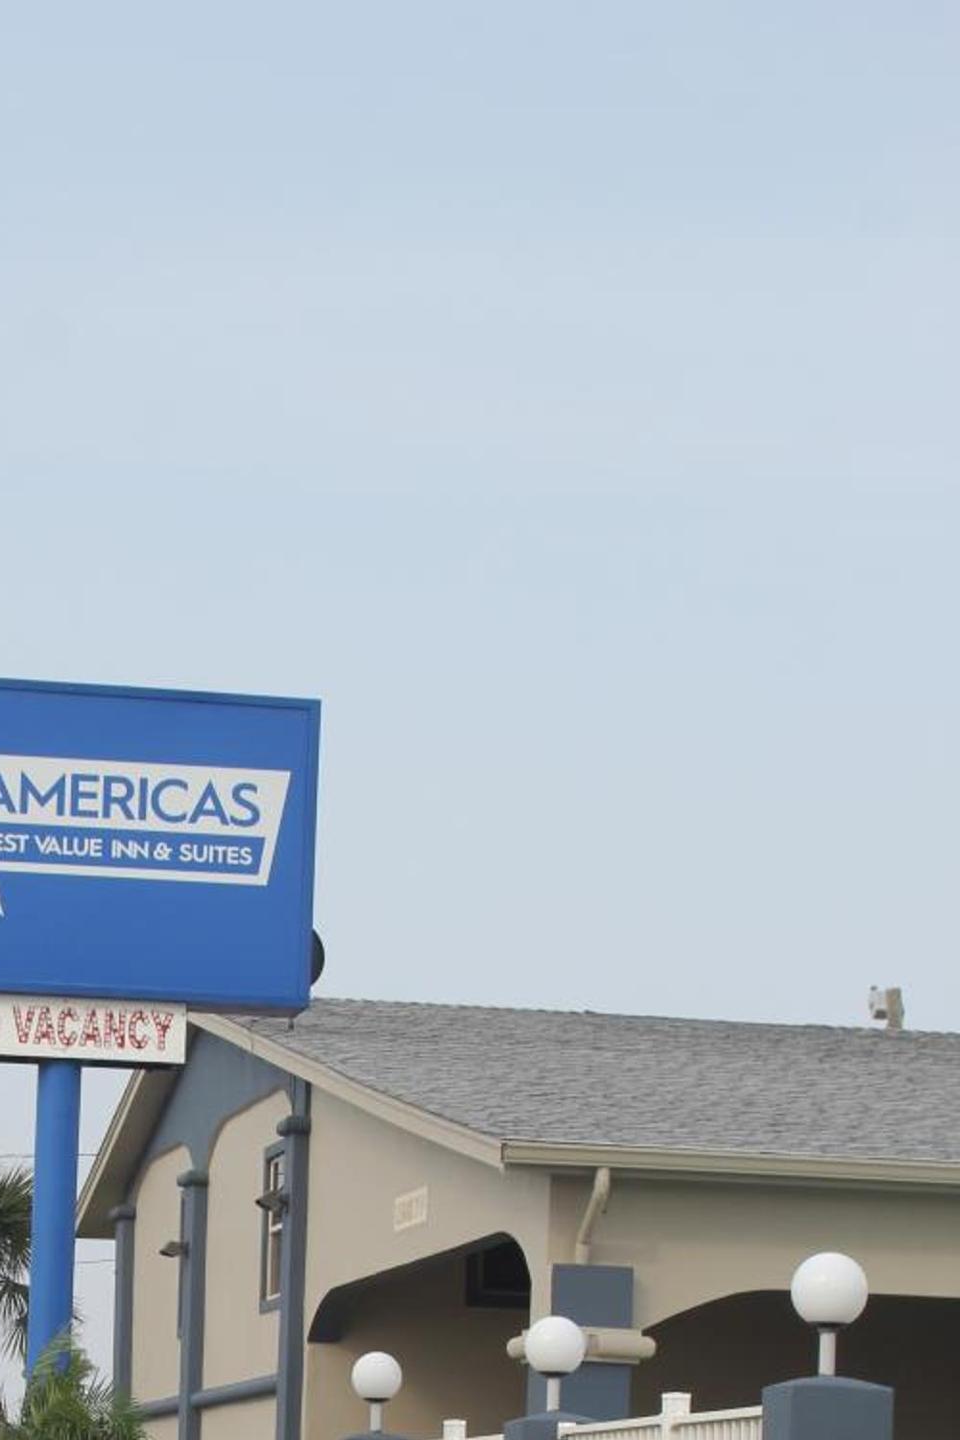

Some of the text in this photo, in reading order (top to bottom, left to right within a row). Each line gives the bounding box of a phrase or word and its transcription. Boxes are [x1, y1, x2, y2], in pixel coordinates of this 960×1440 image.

[35, 834, 103, 857] VALUE
[111, 838, 149, 860] INN
[152, 840, 173, 861] &
[179, 843, 253, 866] SUITES
[13, 1003, 174, 1051] VACANCY
